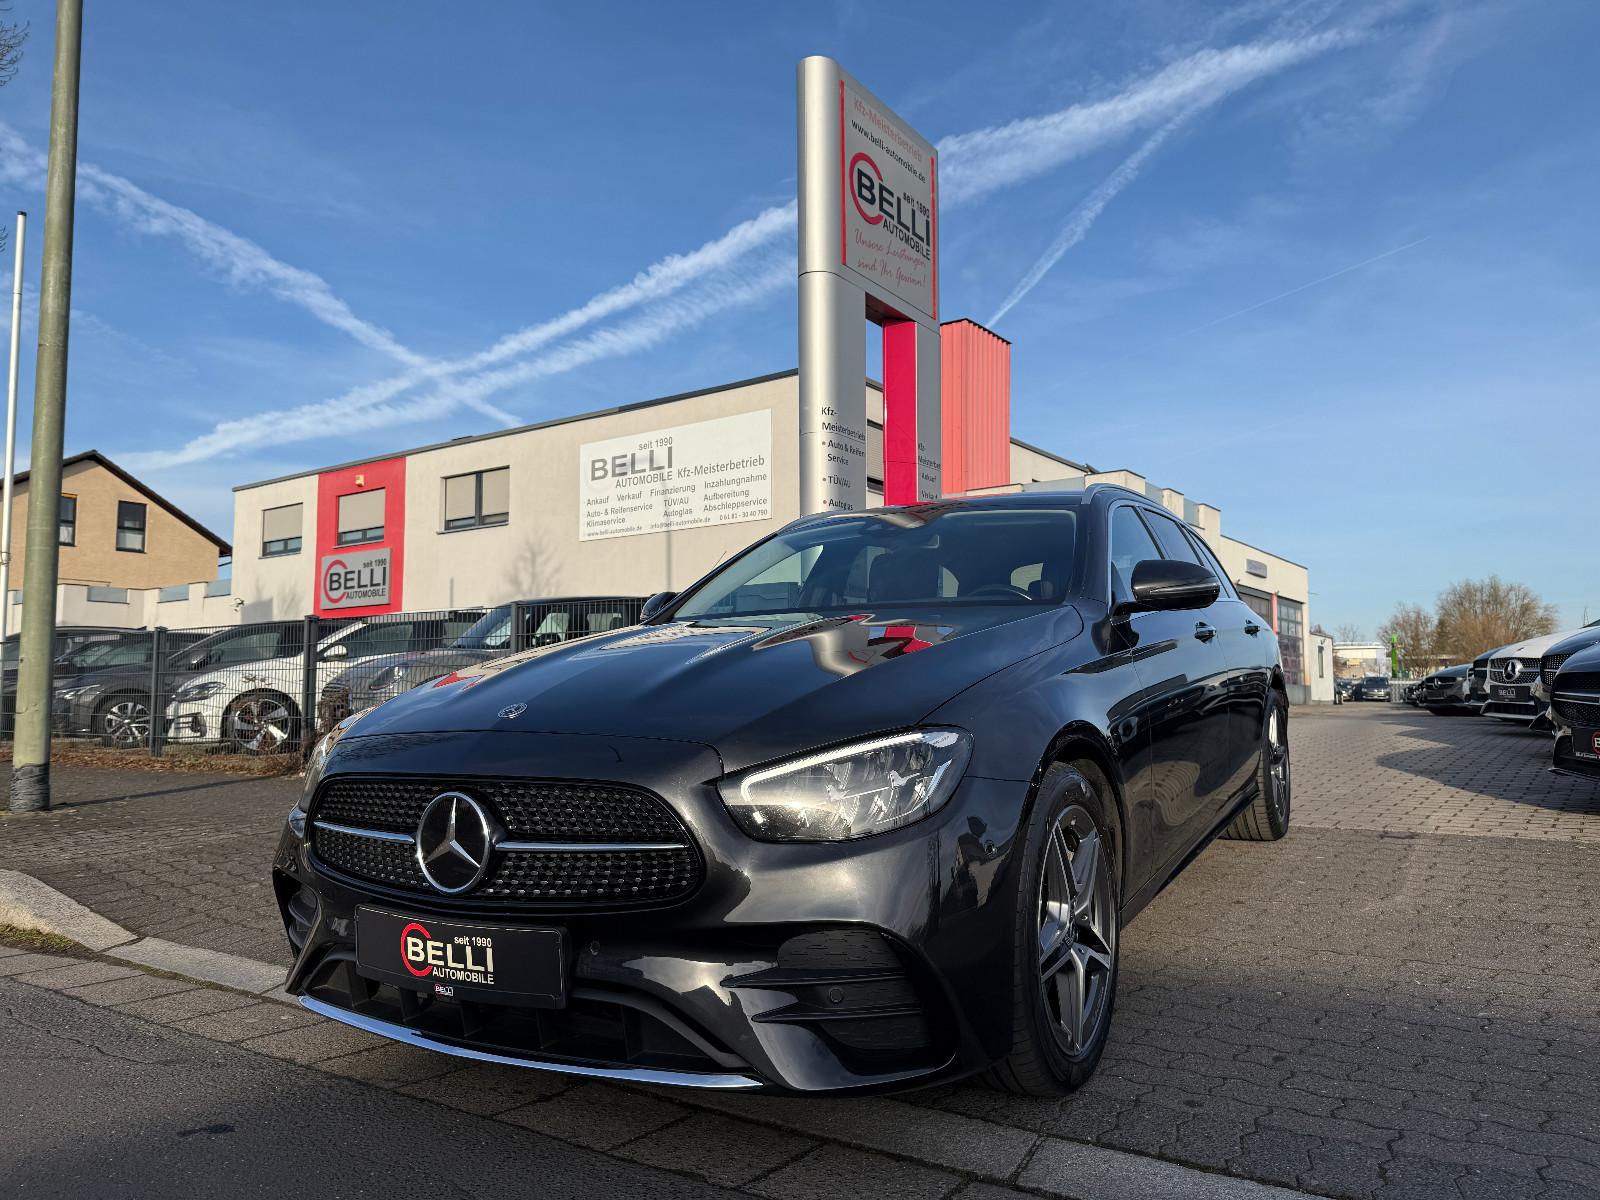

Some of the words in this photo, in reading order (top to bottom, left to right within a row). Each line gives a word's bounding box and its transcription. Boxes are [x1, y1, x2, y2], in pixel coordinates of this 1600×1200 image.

[857, 167, 931, 248] BELLI
[882, 217, 931, 261] AUTOMOBILE
[821, 406, 838, 416] Kfz-
[638, 440, 653, 451] seit
[655, 436, 673, 448] 1990
[828, 439, 844, 450] Auto
[590, 446, 673, 481] BELLI
[677, 455, 765, 478] Kfz-Meisterbetrieb
[586, 496, 610, 506] Ankauf
[616, 491, 642, 502] Verkauf
[650, 483, 696, 497] Finanzierung
[704, 473, 767, 490] Inzahlungnahme
[615, 470, 673, 489] AUTOMOBILE
[586, 516, 626, 528] Klimaservice
[663, 507, 693, 519] Autoglas
[703, 497, 768, 513] Abschleppservice
[610, 502, 653, 516] Reifenservice
[663, 497, 689, 507] TÜV/AU
[703, 488, 750, 502] Aufbereitung
[329, 566, 387, 591] BELLI
[346, 588, 386, 600] AUTOMOBILE
[453, 935, 470, 946] seit
[471, 936, 492, 948] 1990
[406, 936, 494, 973] BELLI
[432, 966, 495, 985] AUTOMOBILE
